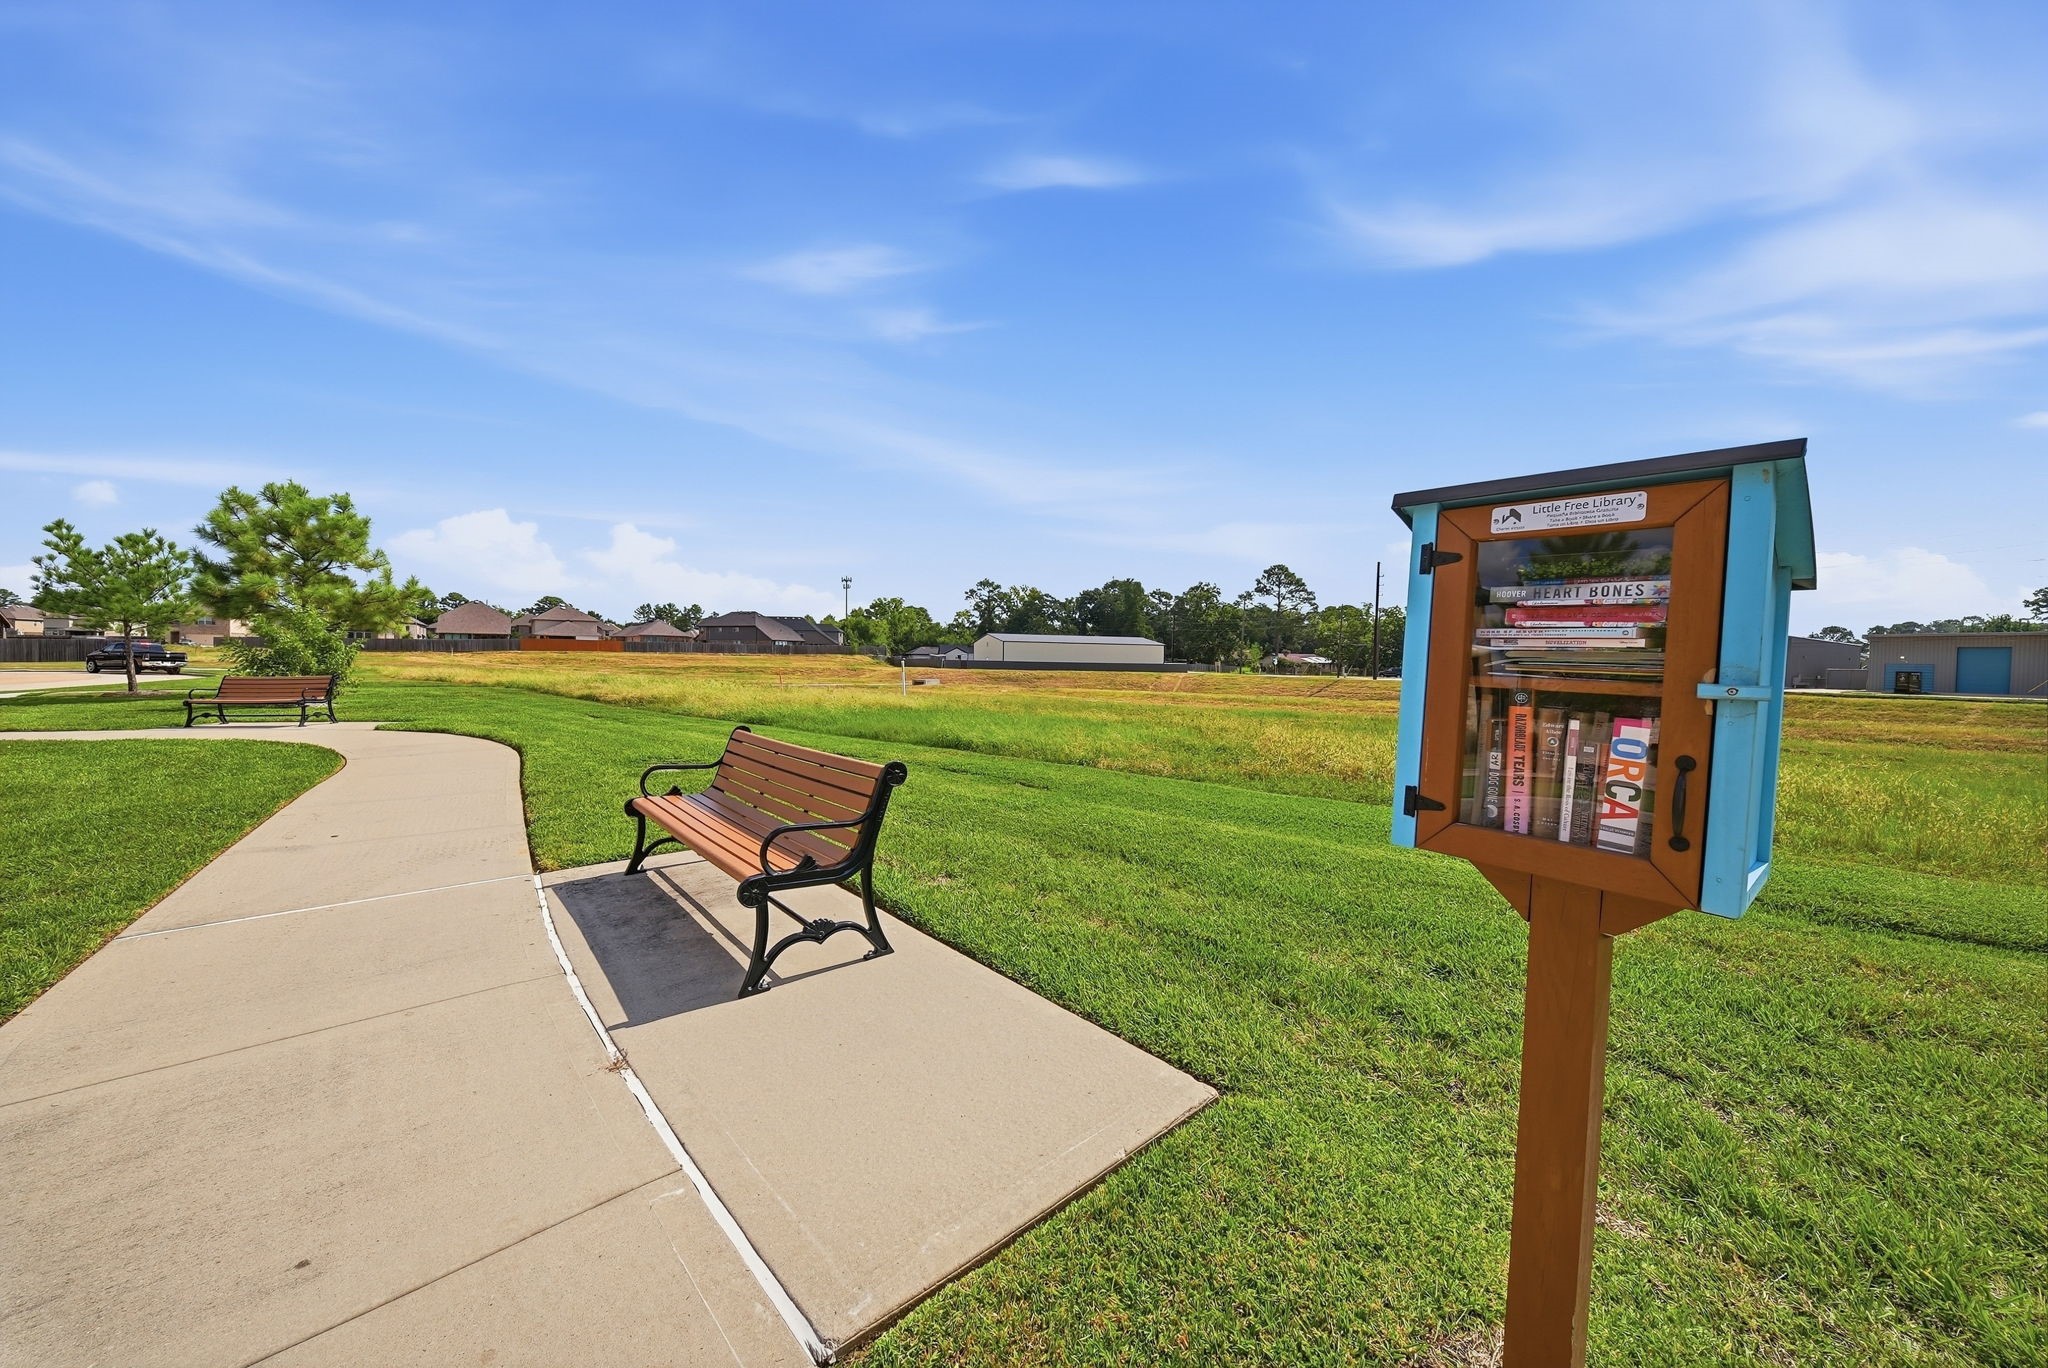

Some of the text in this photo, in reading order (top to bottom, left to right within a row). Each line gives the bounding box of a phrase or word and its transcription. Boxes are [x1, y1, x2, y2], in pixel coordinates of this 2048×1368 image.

[1532, 496, 1636, 514] Little Free Library
[1496, 584, 1644, 599] HOOVER HEART BONES
[1512, 713, 1527, 787] RAZORBLADE TEARS
[1600, 718, 1652, 820] LORCA
[1487, 771, 1500, 804] DOG GONE
